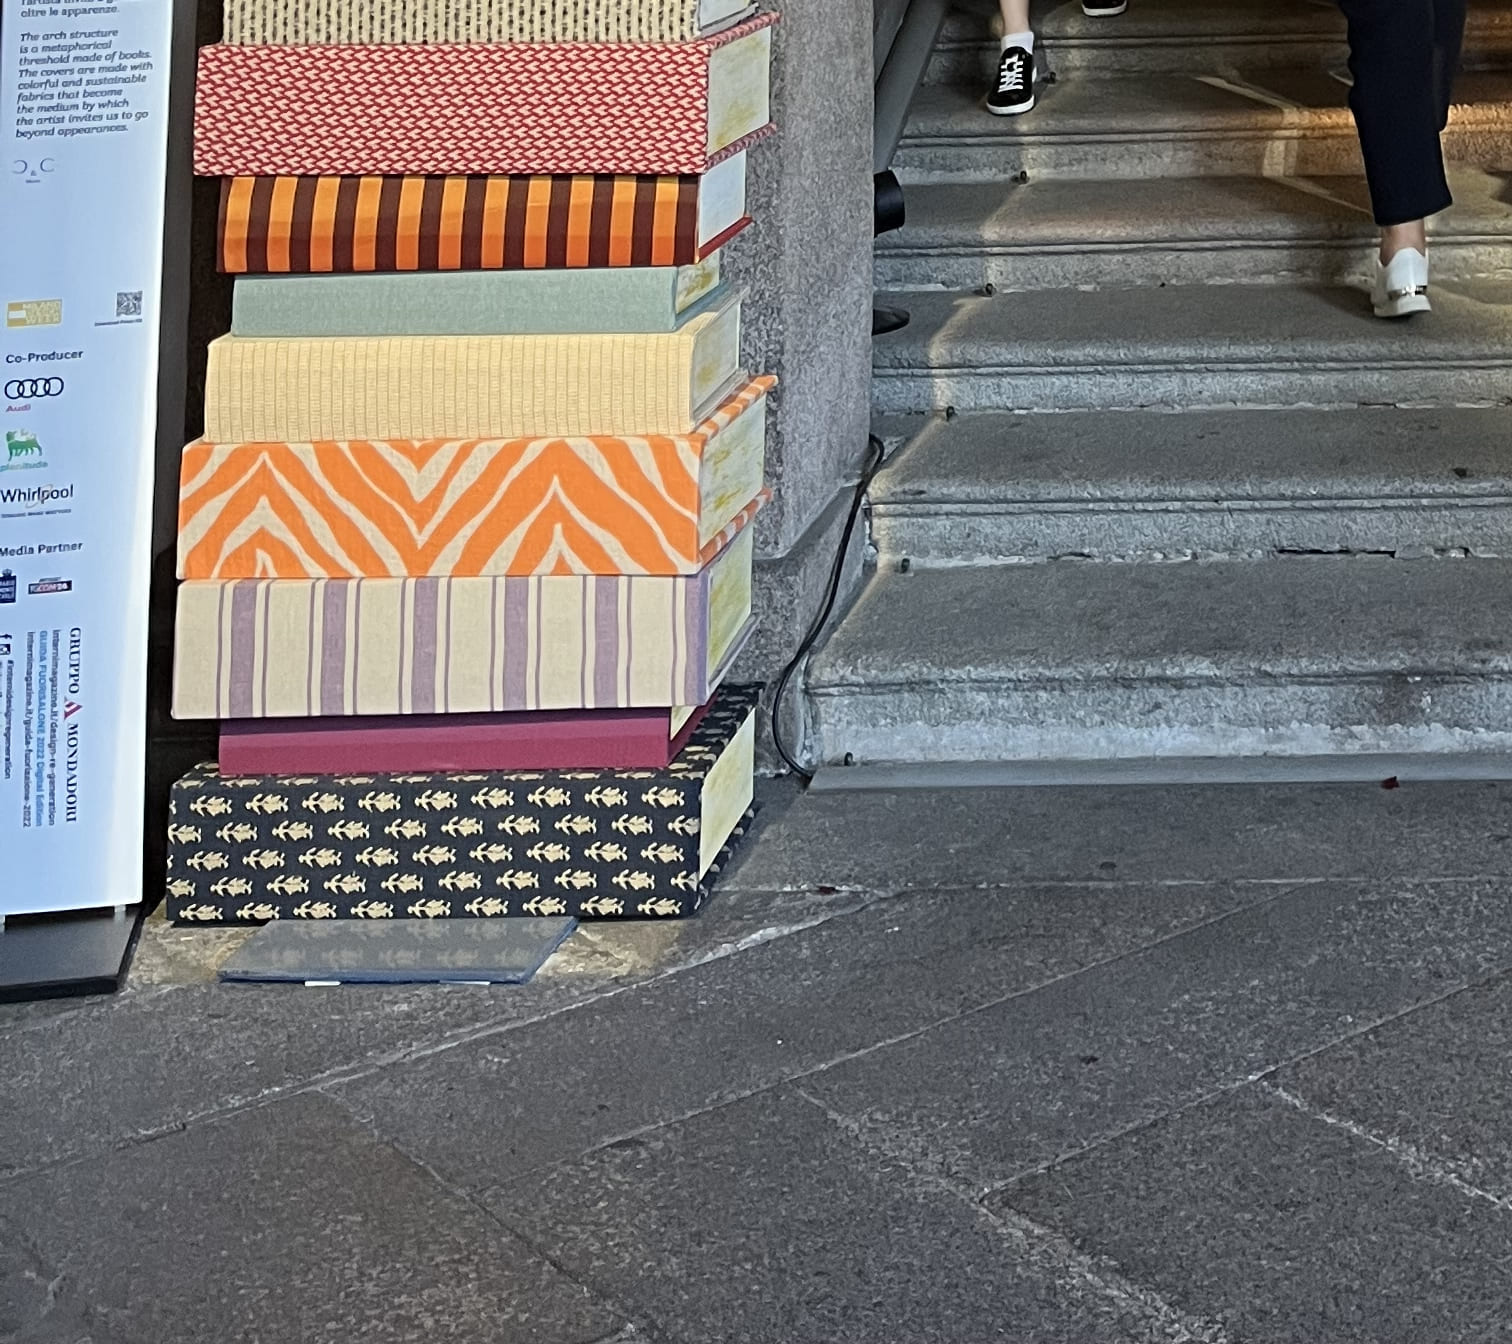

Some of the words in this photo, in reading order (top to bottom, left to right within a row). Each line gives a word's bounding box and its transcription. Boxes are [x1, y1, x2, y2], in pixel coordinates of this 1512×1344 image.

[20, 8, 47, 18] oltre
[49, 7, 59, 16] le
[20, 32, 39, 42] The
[42, 31, 67, 41] arch
[69, 29, 119, 39] structure
[19, 45, 29, 54] is
[31, 45, 38, 53] a
[41, 40, 113, 53] metaphorical
[19, 54, 70, 66] threshold
[72, 54, 102, 62] made
[105, 51, 117, 63] of
[18, 69, 37, 78] The
[40, 67, 75, 77] covers
[77, 66, 96, 74] are
[98, 64, 128, 73] made
[130, 62, 153, 71] with
[17, 79, 59, 90] colorful
[61, 78, 82, 87] and
[85, 74, 147, 86] sustainable
[16, 92, 55, 104] fabrics
[57, 90, 80, 100] that
[82, 89, 123, 98] become
[16, 105, 35, 114] the
[36, 103, 79, 113] medium
[82, 101, 95, 112] by
[98, 99, 129, 109] which
[16, 117, 34, 126] the
[36, 115, 65, 125] artist
[68, 113, 103, 123] invites
[106, 112, 119, 120] us
[121, 111, 133, 120] to
[134, 111, 149, 121] go
[15, 127, 55, 140] beyond
[6, 350, 84, 364] Co-Producer
[6, 404, 31, 413] Audi
[0, 484, 74, 504] Whirlpool
[0, 544, 34, 557] Media
[38, 543, 83, 554] Partner
[39, 630, 48, 662] GUIDA
[68, 627, 81, 694] GRUPPO
[65, 723, 79, 823] MONDADORI
